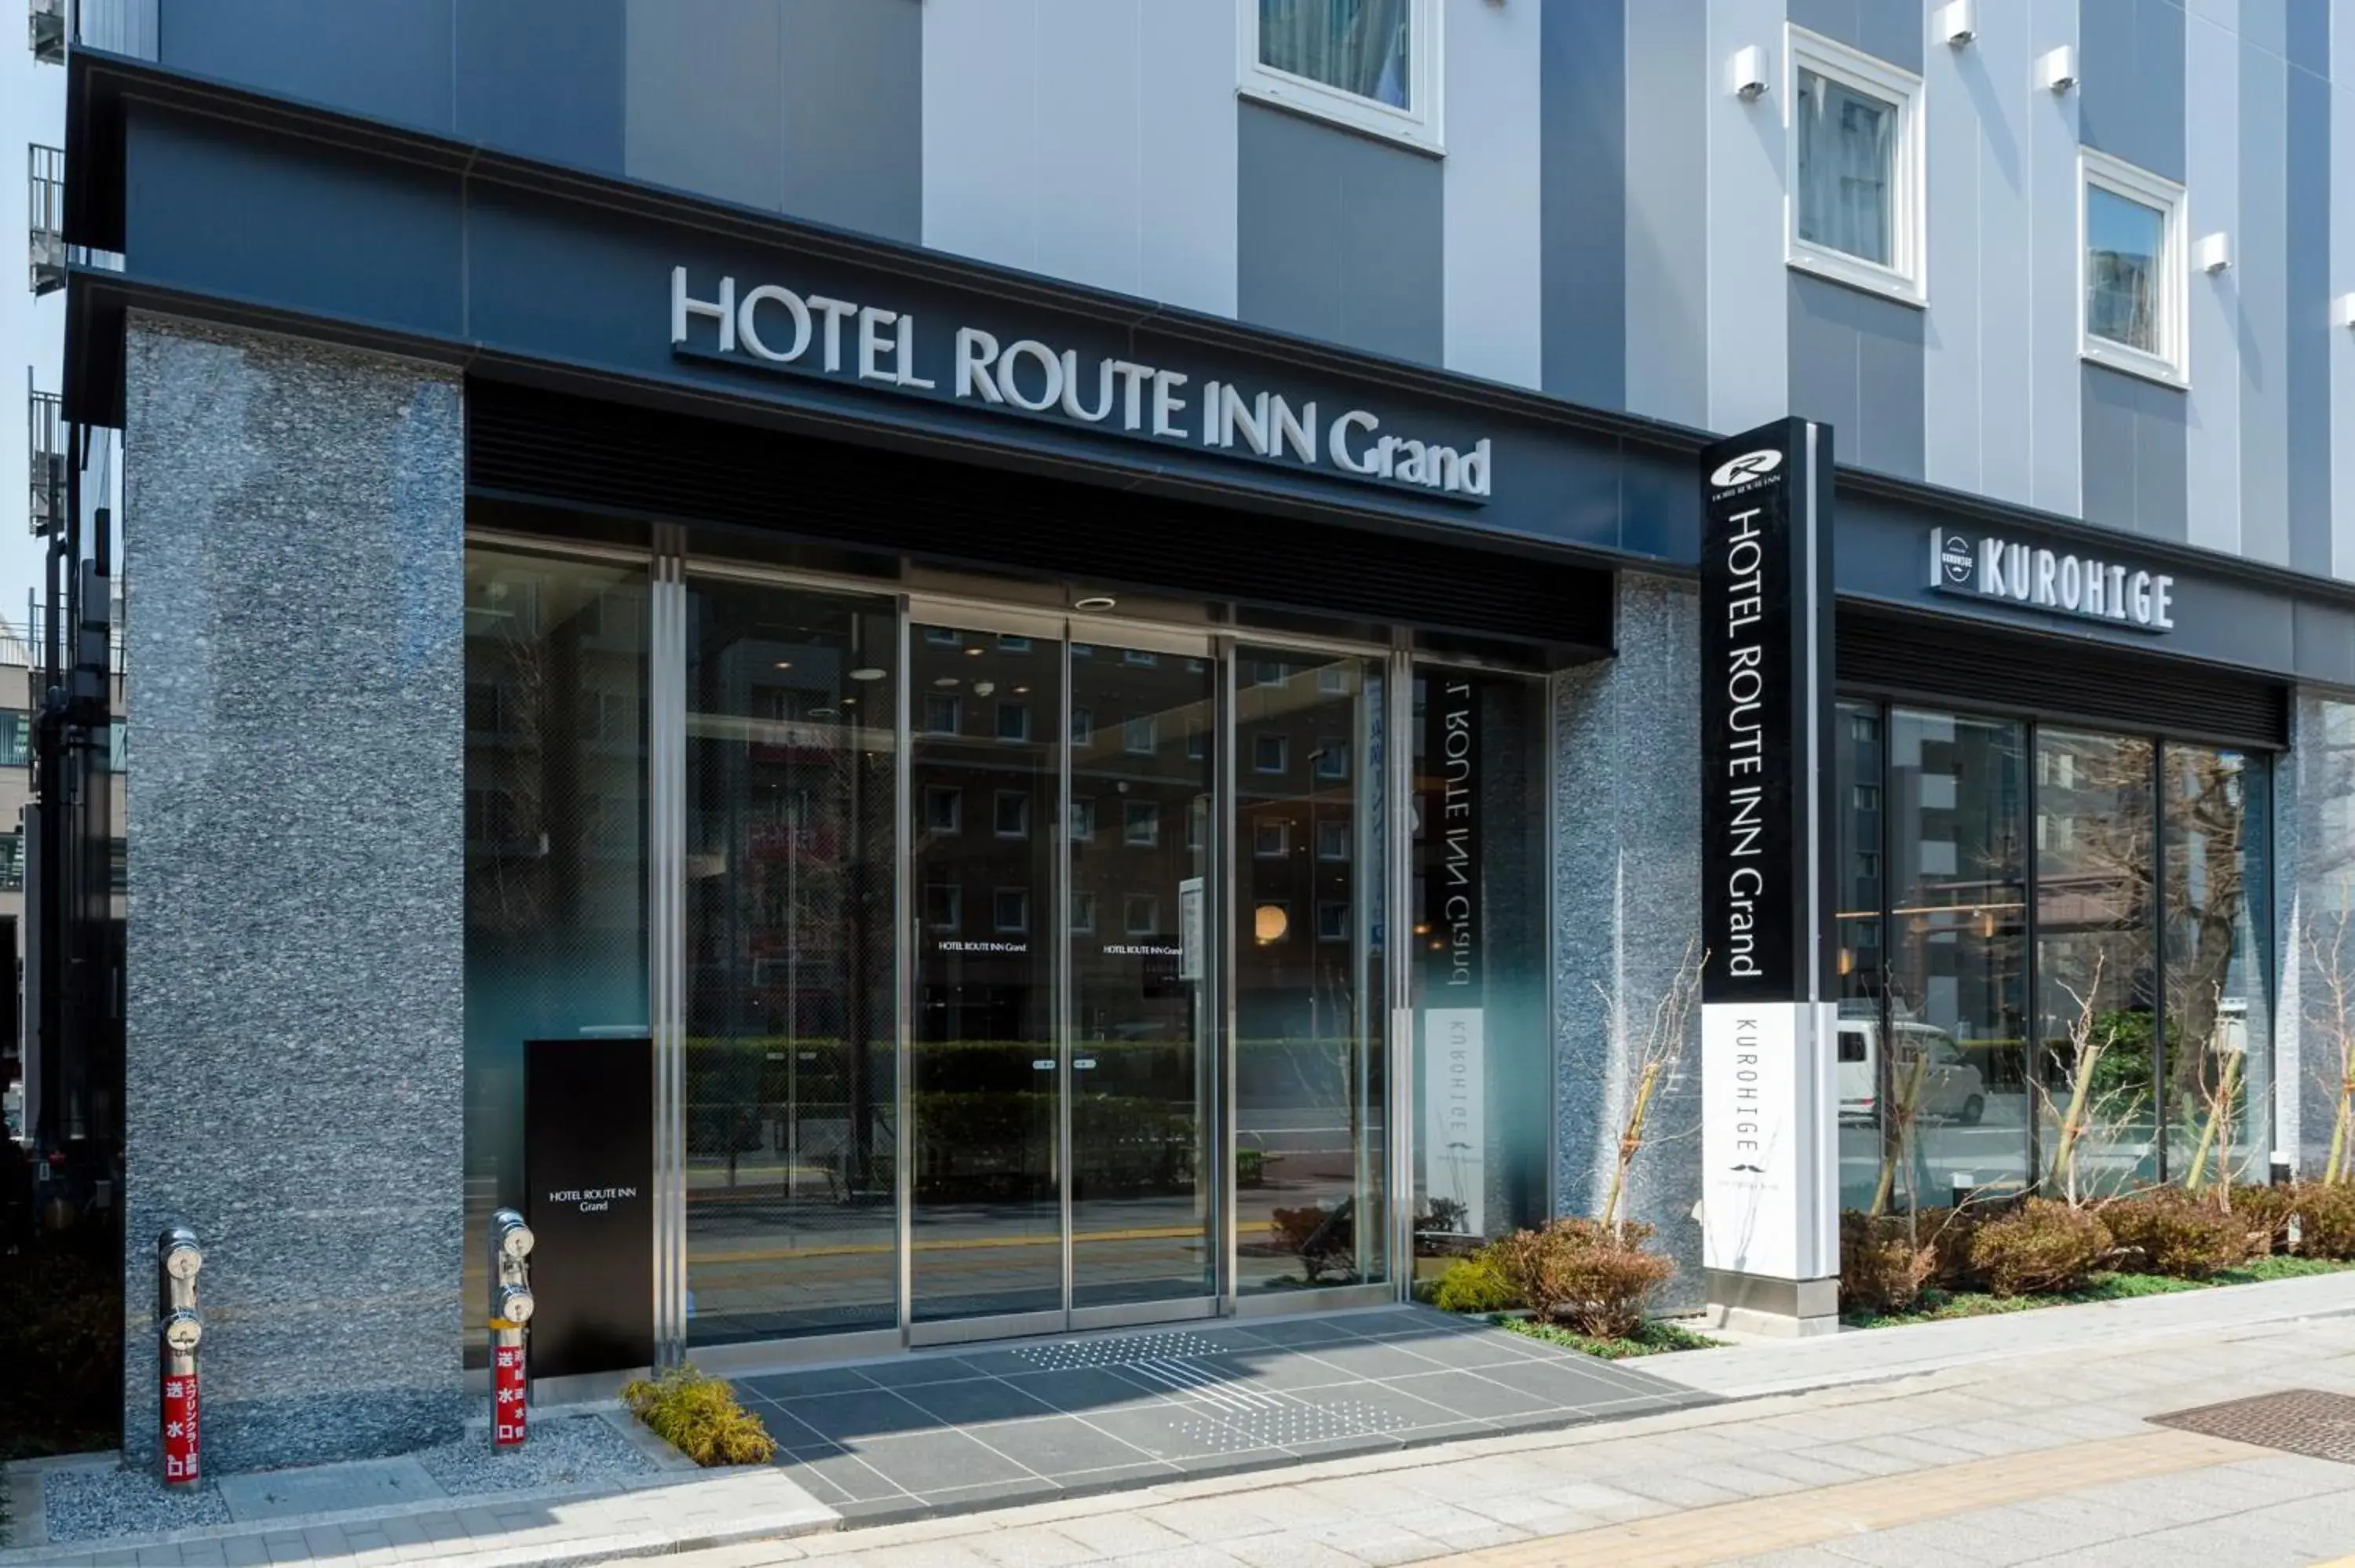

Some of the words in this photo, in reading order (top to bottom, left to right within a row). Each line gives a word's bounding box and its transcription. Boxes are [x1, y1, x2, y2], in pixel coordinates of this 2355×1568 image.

[671, 265, 935, 388] HOTEL
[955, 326, 1188, 439] ROUTE
[1203, 381, 1316, 465] INN
[1329, 410, 1491, 496] Grand
[1728, 507, 1762, 639] HOTEL
[1978, 537, 2174, 629] KUROHIGE
[1729, 644, 1762, 777] ROUTE
[1729, 786, 1762, 857] INN
[1729, 867, 1762, 976] Grand
[1736, 1019, 1758, 1150] KUROHIGE
[550, 1191, 581, 1202] HOTEL
[583, 1188, 616, 1200] ROUTE
[618, 1187, 637, 1198] INN
[579, 1201, 608, 1212] Grand
[166, 1380, 184, 1476] 送水口
[498, 1351, 514, 1439] 送水口
